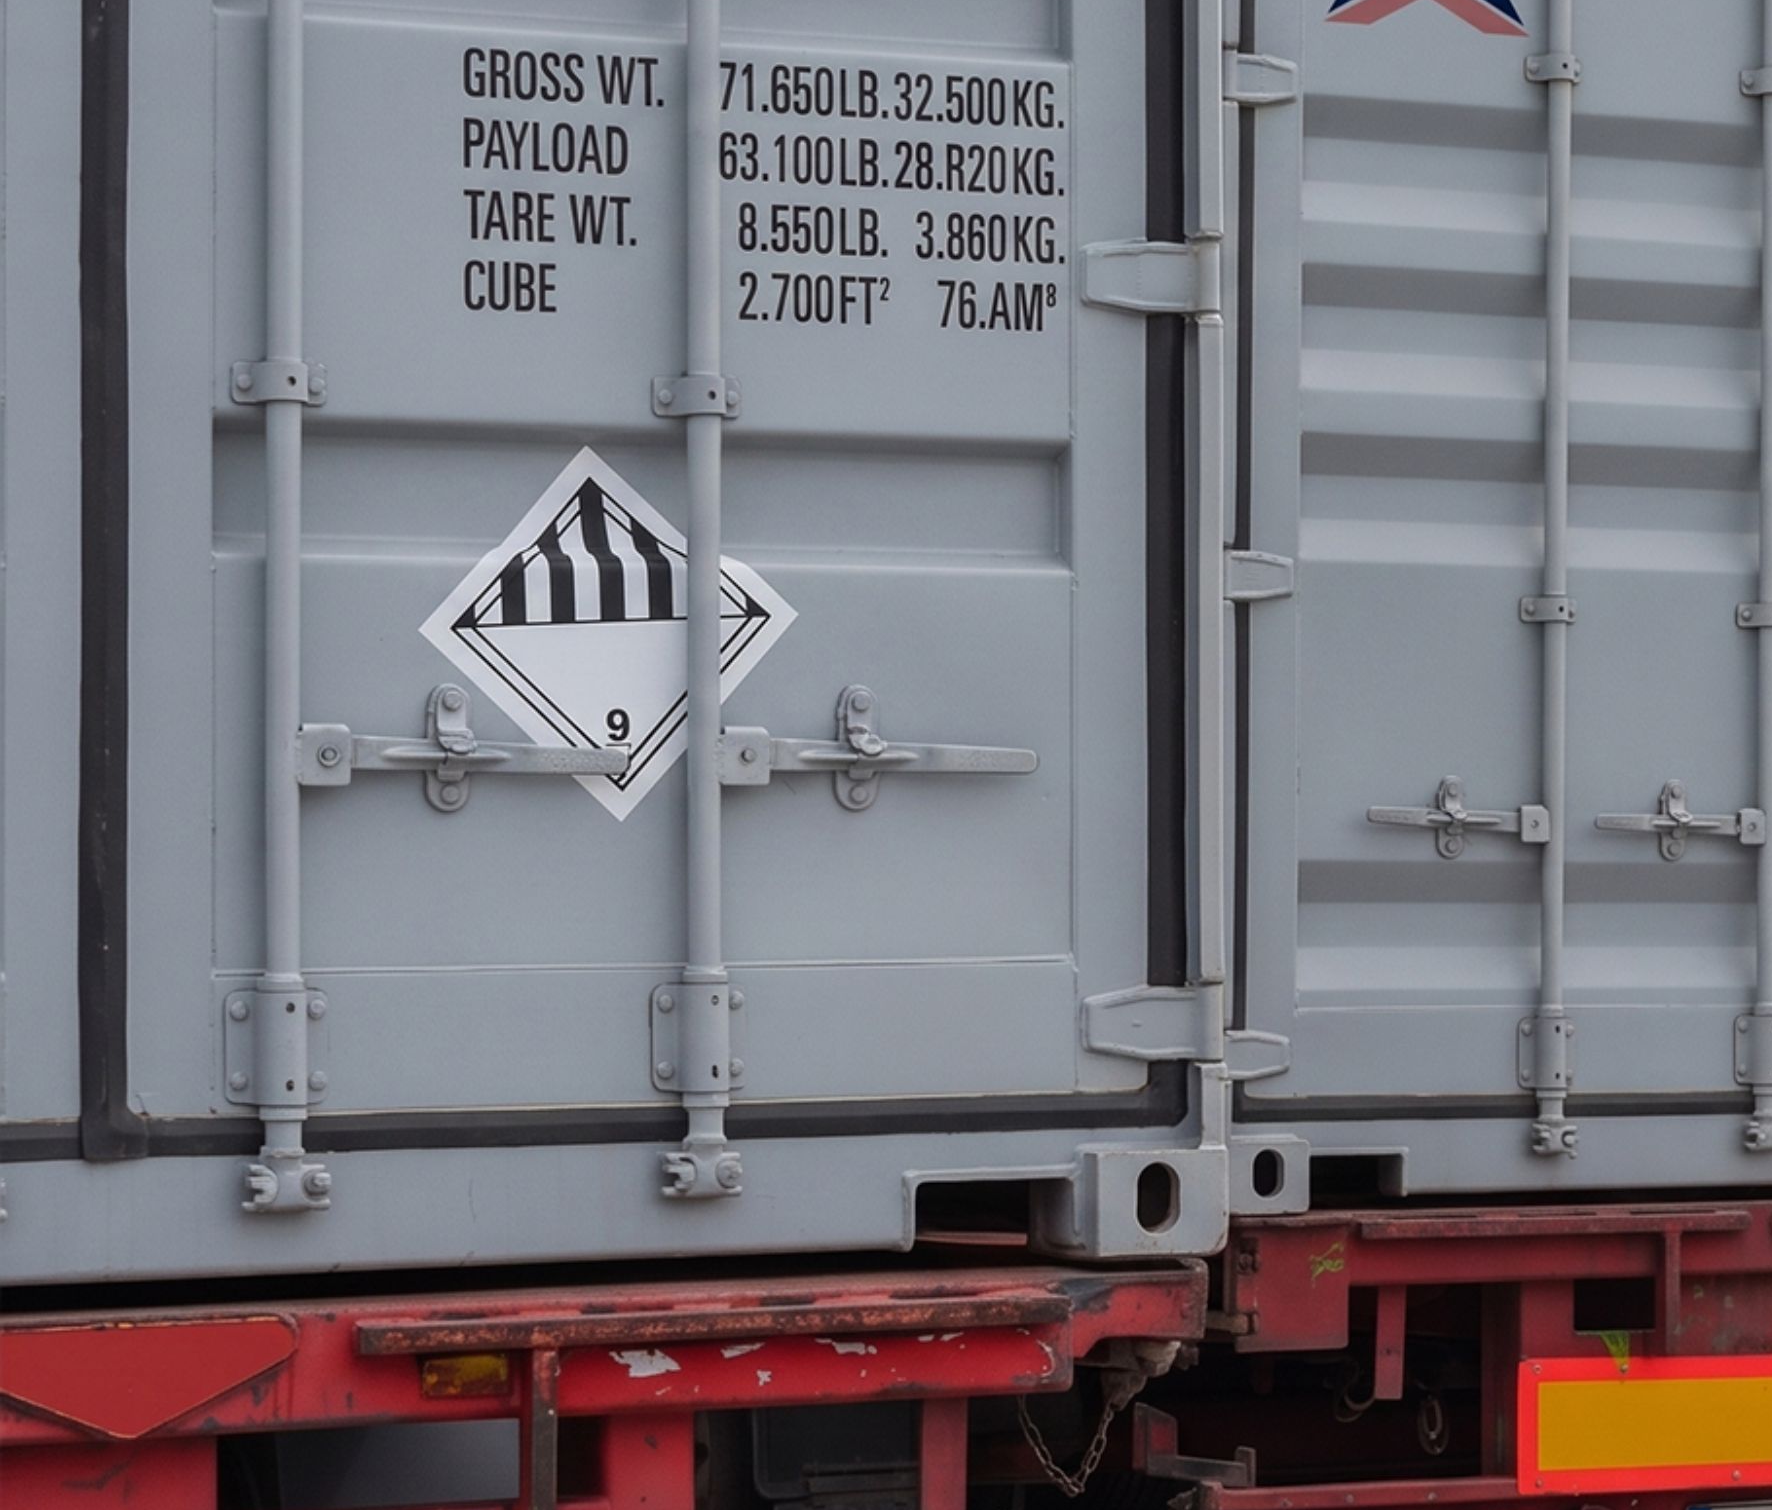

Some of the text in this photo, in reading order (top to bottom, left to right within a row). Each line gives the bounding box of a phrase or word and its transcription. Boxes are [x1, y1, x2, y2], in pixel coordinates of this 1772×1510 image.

[463, 47, 585, 103] GROSS
[598, 55, 665, 107] WT.
[463, 118, 629, 175] PAYLOAD
[464, 189, 555, 242] TARE
[569, 194, 637, 247] WT.
[463, 260, 557, 313] CUBE
[606, 708, 631, 742] 9
